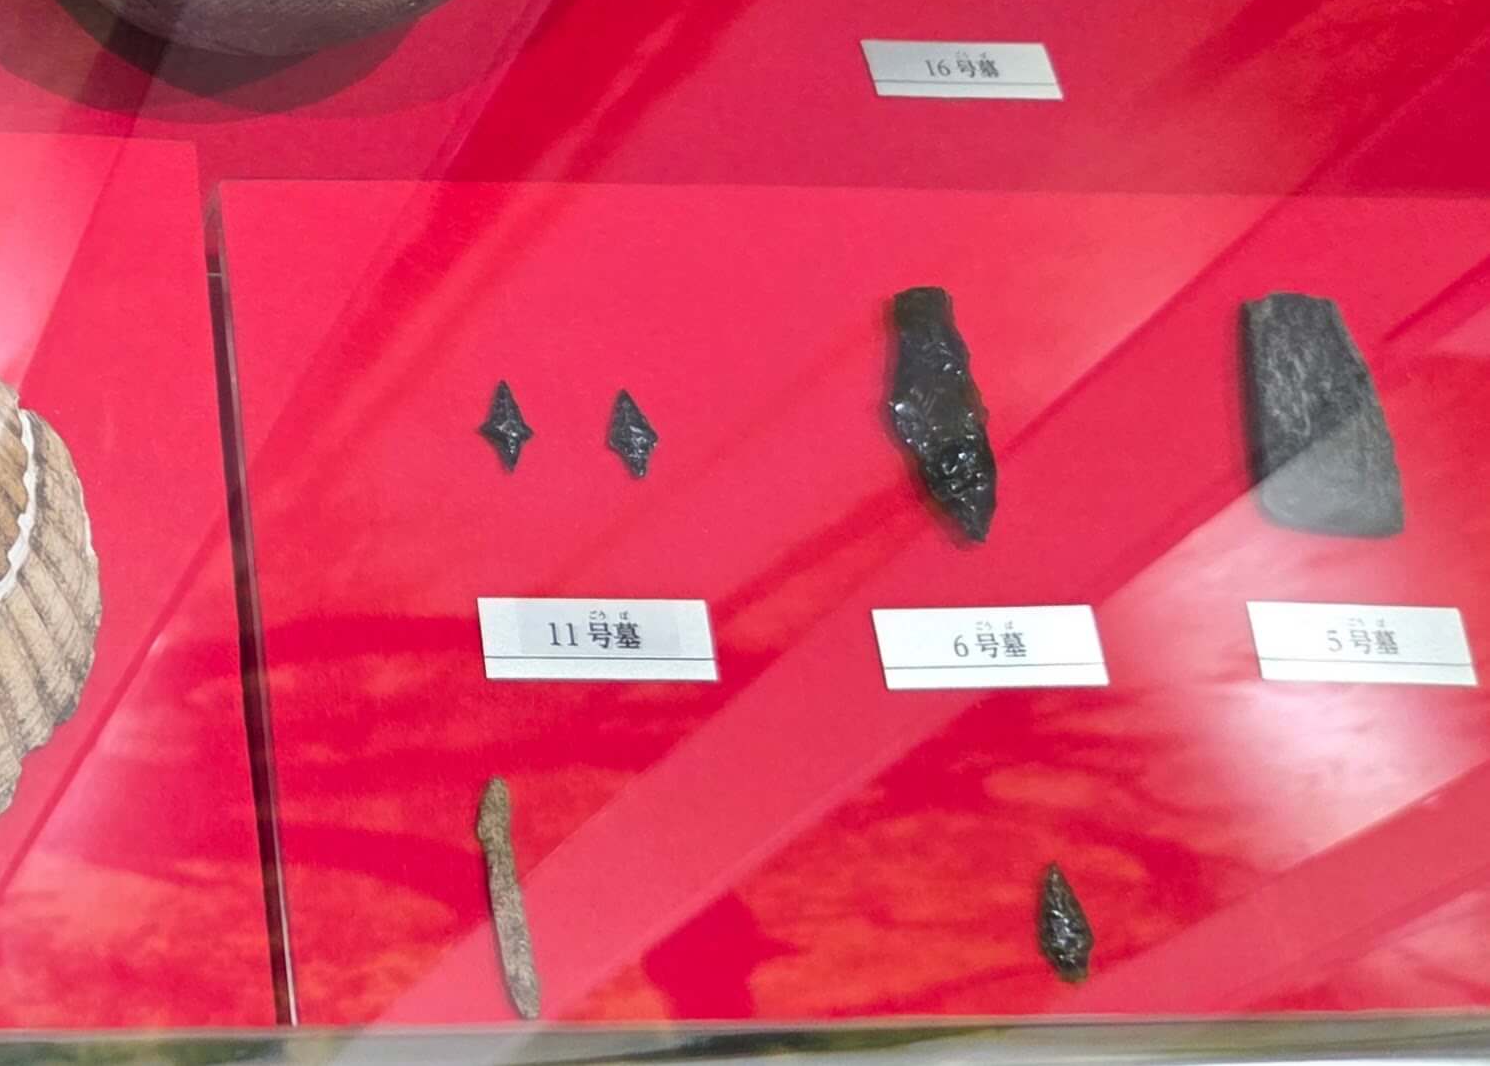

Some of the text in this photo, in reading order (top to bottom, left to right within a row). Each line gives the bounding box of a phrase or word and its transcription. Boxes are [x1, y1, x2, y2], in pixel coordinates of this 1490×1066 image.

[924, 58, 1000, 79] 16号墓
[548, 621, 641, 650] 11号墓
[953, 632, 1028, 659] 6号墓
[1326, 629, 1400, 655] 5号墓
